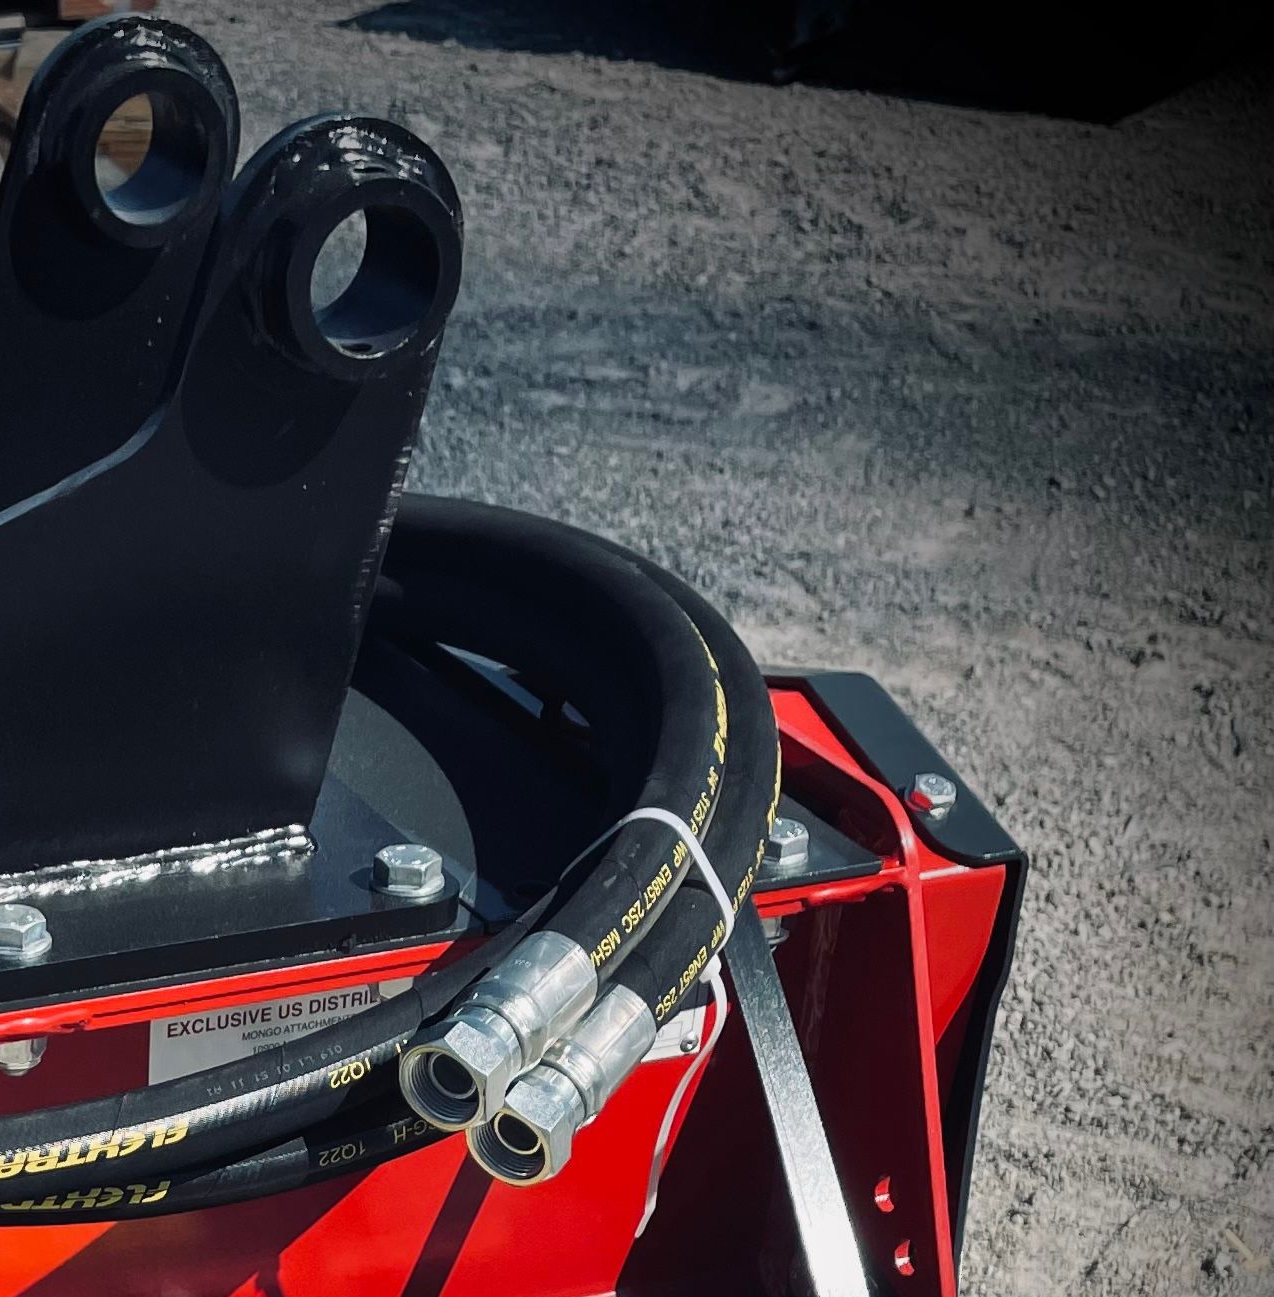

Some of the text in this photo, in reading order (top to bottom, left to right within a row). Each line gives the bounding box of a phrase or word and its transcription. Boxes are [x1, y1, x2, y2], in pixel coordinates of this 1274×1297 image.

[621, 898, 647, 934] 2SC
[167, 1006, 272, 1039] EXCLUSIVE
[278, 1002, 303, 1020] US
[241, 1026, 282, 1042] MONGO
[329, 1057, 373, 1089] 1Q22
[318, 1140, 366, 1167] 1Q22
